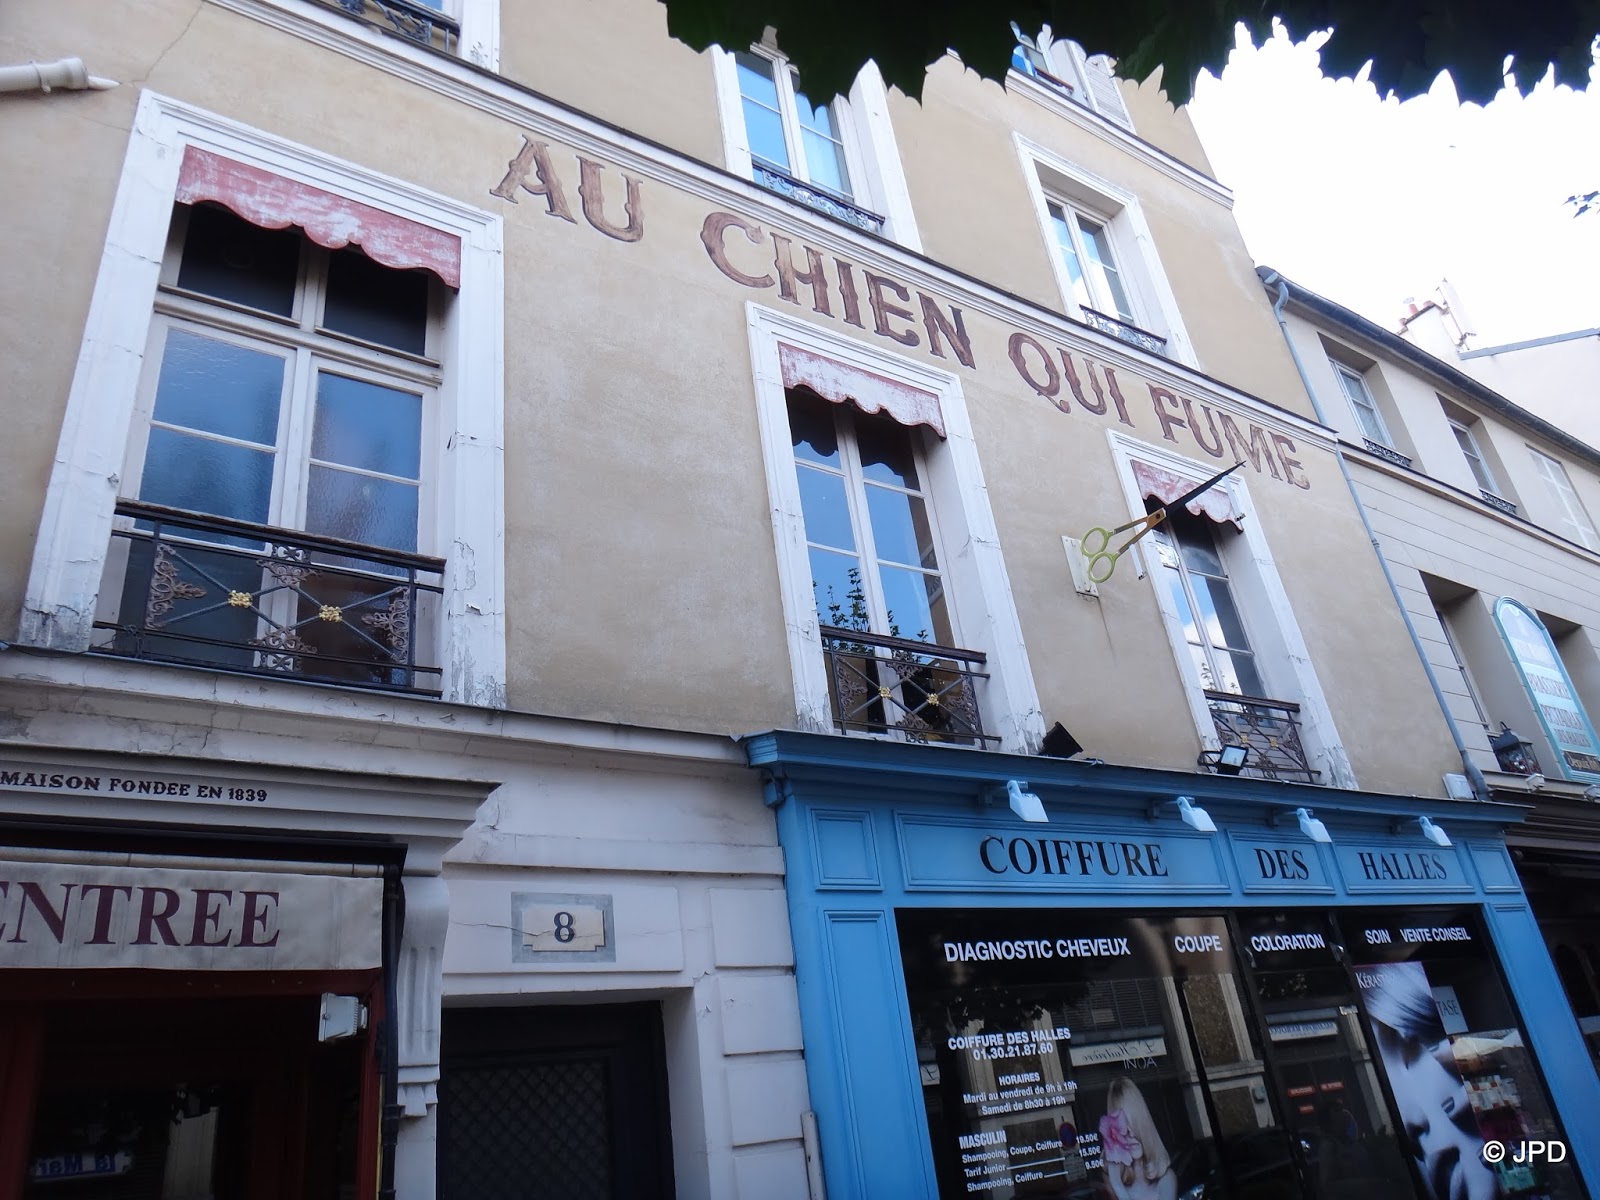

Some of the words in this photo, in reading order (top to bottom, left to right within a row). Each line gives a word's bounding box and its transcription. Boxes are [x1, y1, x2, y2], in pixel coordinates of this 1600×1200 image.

[489, 134, 644, 243] AU
[700, 211, 977, 370] CHIEN
[1008, 332, 1135, 428] QUI
[1146, 382, 1311, 490] FUME
[1, 771, 100, 791] MAISON
[108, 778, 190, 797] FONDEE
[197, 785, 223, 799] EN
[228, 787, 267, 802] 1839
[980, 835, 1168, 877] COIFFURE
[1254, 847, 1310, 881] DES
[1358, 852, 1448, 881] HALLES
[0, 881, 280, 948] NTREE
[554, 911, 575, 943] 8
[1365, 929, 1391, 944] SOIN
[1400, 928, 1433, 942] VENTE
[1432, 927, 1471, 941] CONSEIL
[944, 940, 1053, 962] DIAGNOSTIC
[1056, 938, 1131, 957] CHEVEUX
[1174, 935, 1223, 953] COUPE
[1251, 933, 1325, 952] COLORATION
[948, 1033, 1005, 1050] COIFFURE
[1007, 1032, 1029, 1046] DES
[1031, 1028, 1071, 1042] HALLES
[973, 1042, 1053, 1060] 01.30.21.87.60
[999, 1072, 1040, 1086] HORAIRES
[963, 1092, 987, 1104] Mardi
[989, 1092, 998, 1100] au
[1000, 1086, 1033, 1099] vendredi
[1035, 1085, 1044, 1095] de
[1046, 1083, 1055, 1093] 9h
[1057, 1081, 1062, 1091] à
[1063, 1080, 1077, 1091] 19h
[982, 1102, 1012, 1116] Samedi
[1013, 1101, 1023, 1111] de
[1024, 1098, 1044, 1109] 8h30
[1045, 1097, 1050, 1106] à
[1052, 1095, 1066, 1106] 19h
[958, 1130, 1007, 1150] MASCULIN
[1036, 1139, 1063, 1151] Coiffure
[964, 1168, 981, 1178] Tarif
[983, 1164, 1006, 1175] Junior
[1015, 1171, 1043, 1183] Coiffure
